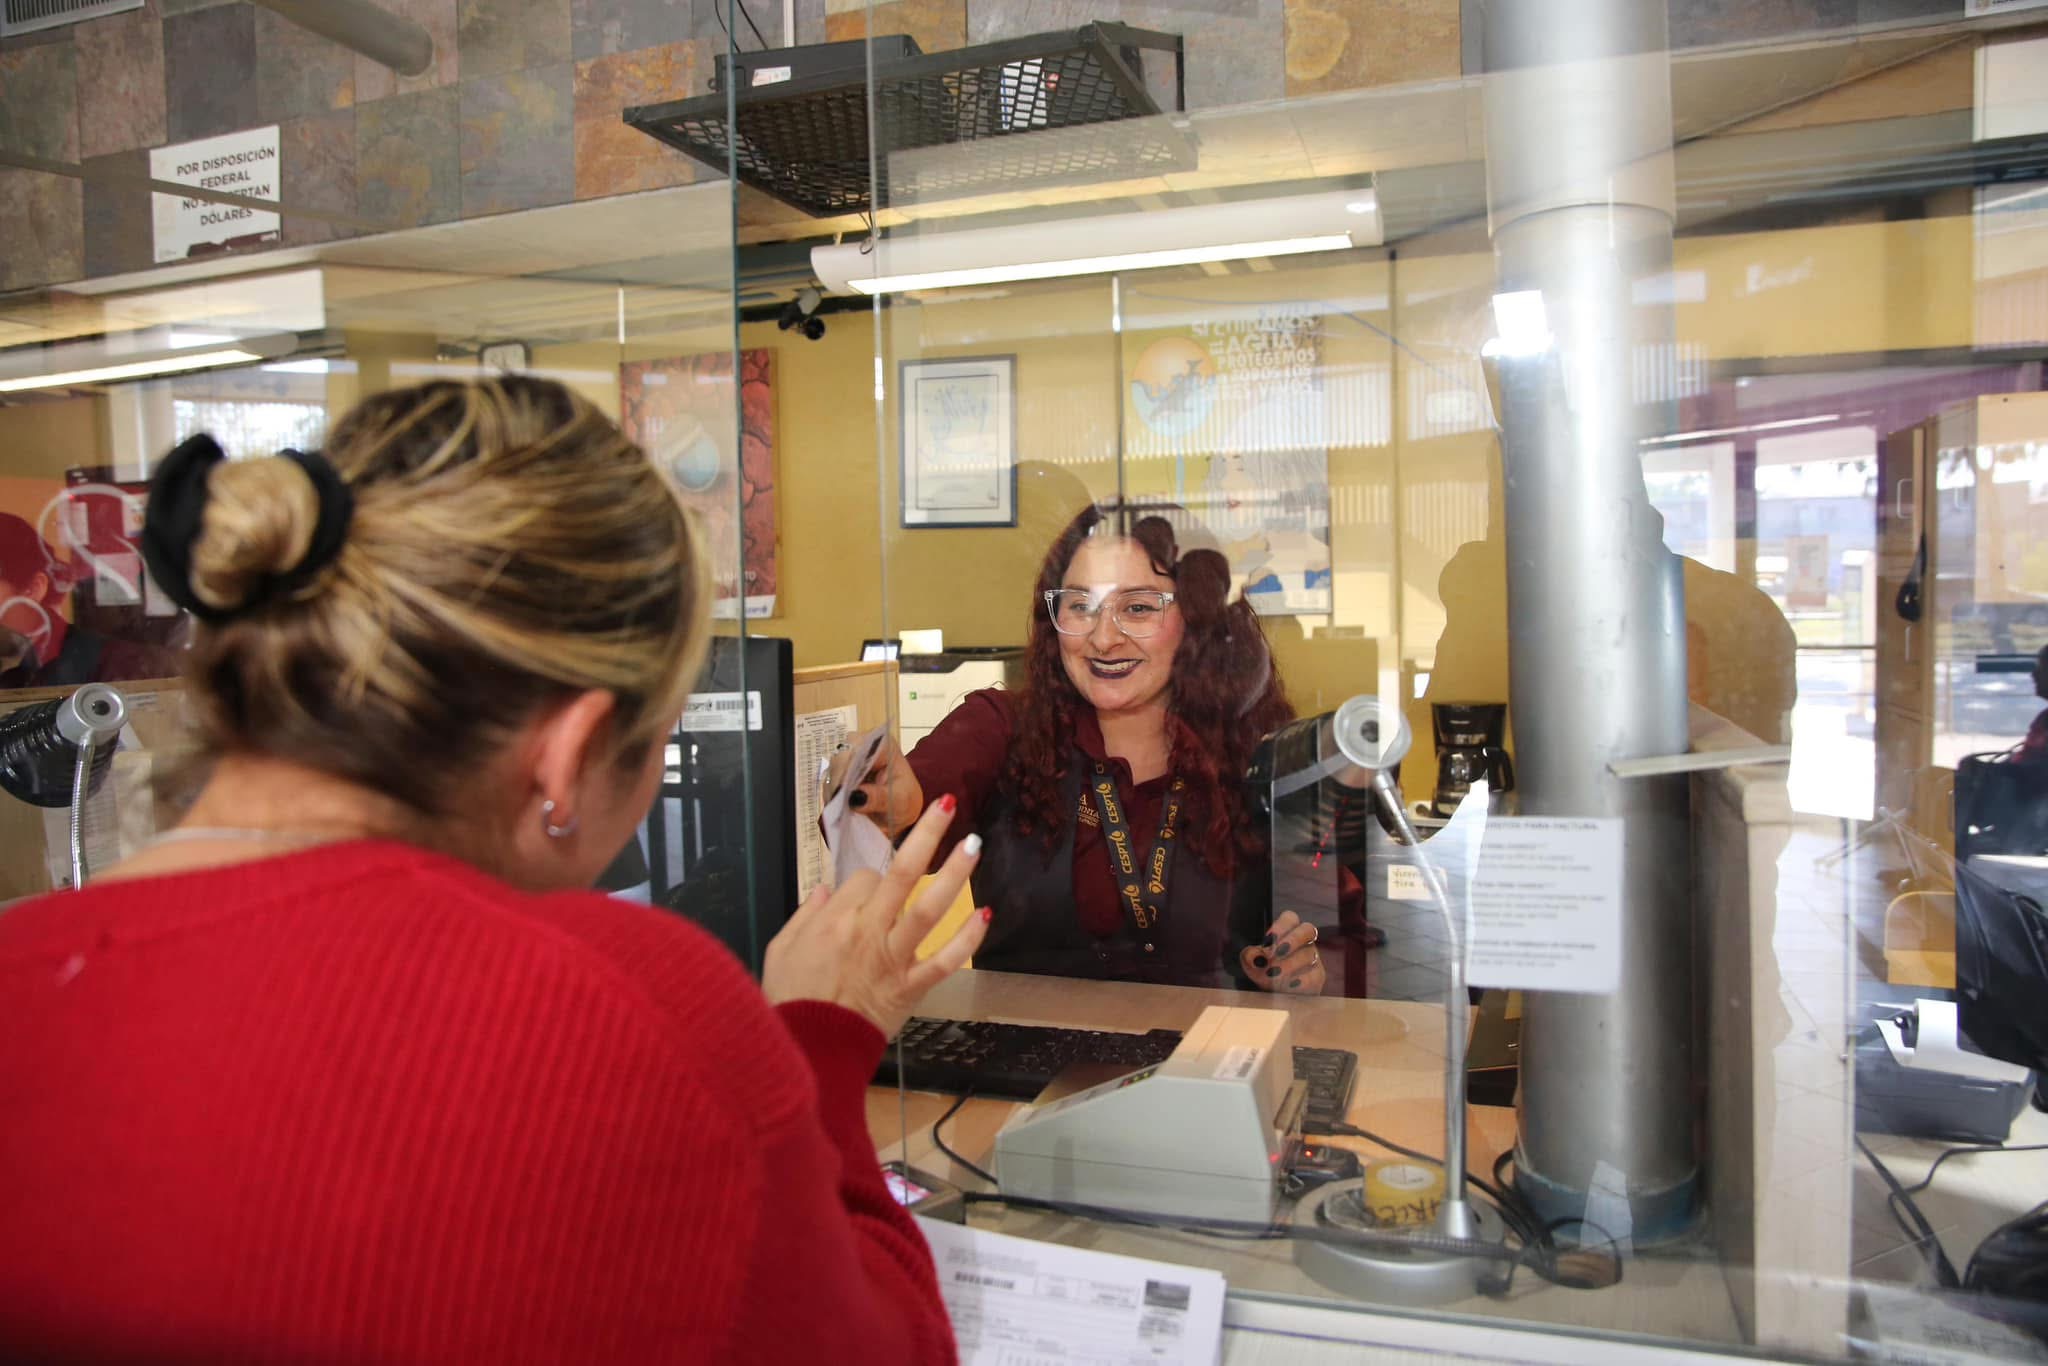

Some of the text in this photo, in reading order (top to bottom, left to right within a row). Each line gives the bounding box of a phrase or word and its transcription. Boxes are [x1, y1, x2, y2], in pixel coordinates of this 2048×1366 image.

[177, 148, 275, 177] POR DISPOSICIÓN
[200, 170, 251, 188] FEDERAL
[182, 199, 199, 211] NO
[201, 208, 252, 225] DÓLARES
[1227, 331, 1297, 354] AGUA
[1217, 347, 1316, 370] PROTEGEMOS
[1104, 794, 1120, 823] CESPT
[1115, 842, 1133, 873] CESPT
[1152, 847, 1166, 881] CESPT
[1130, 897, 1148, 928] CESPT
